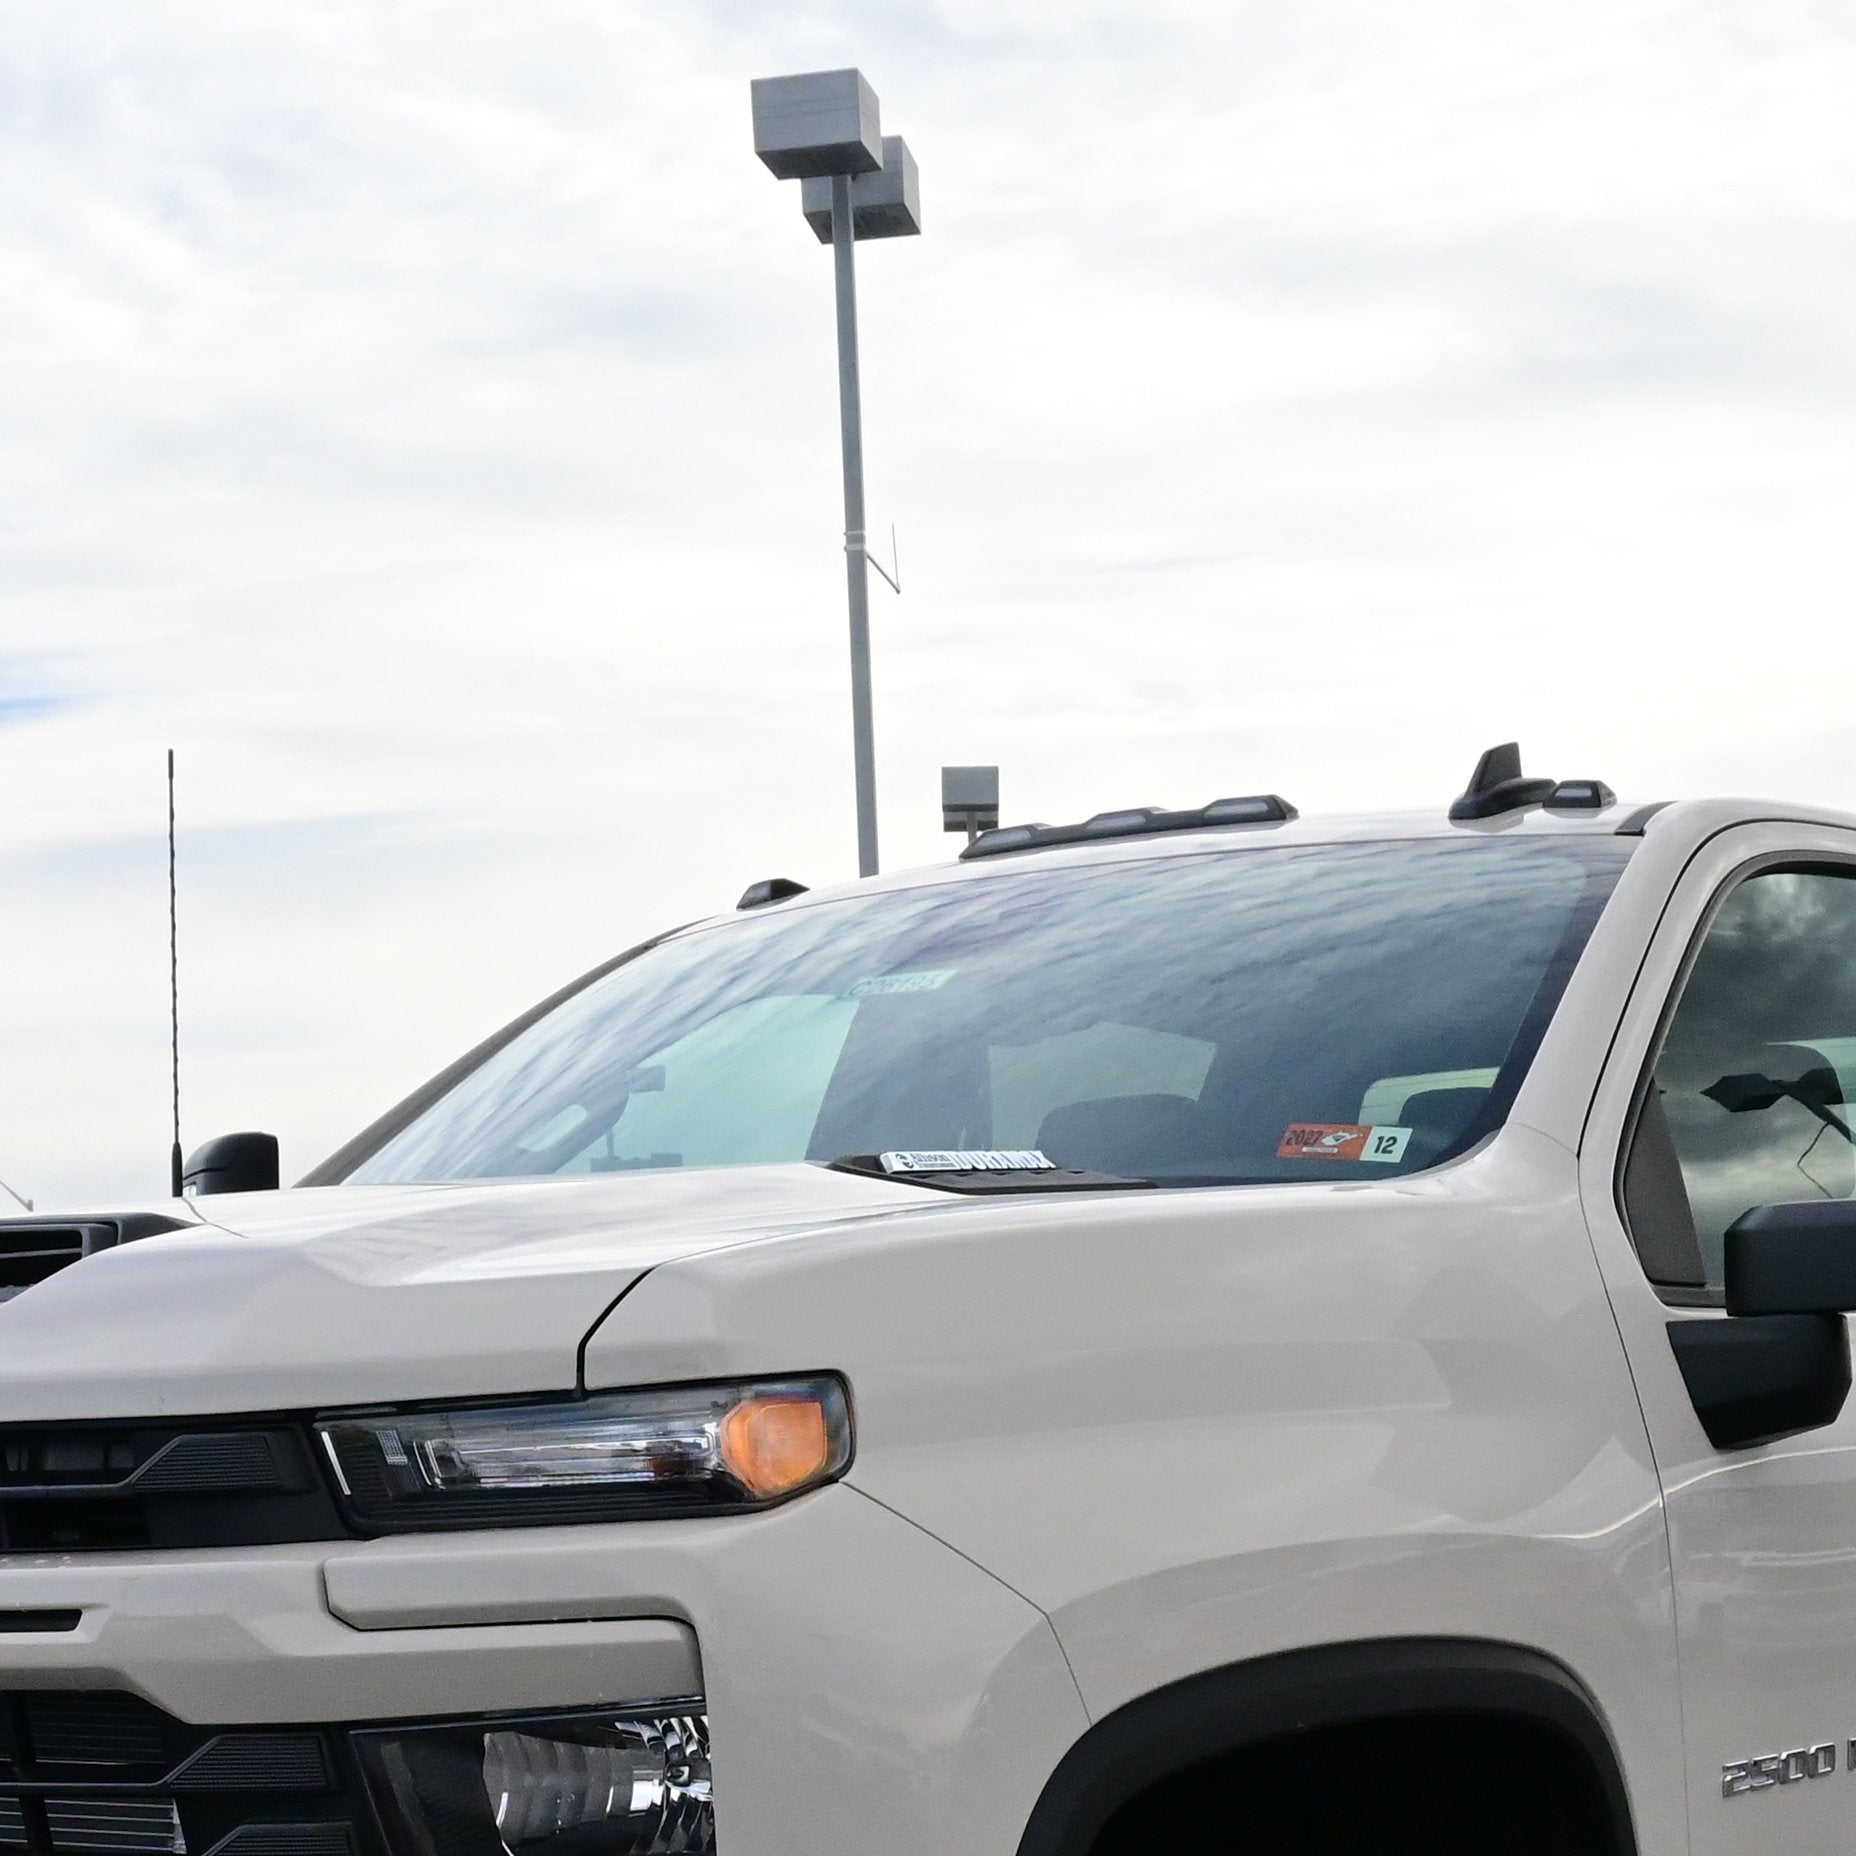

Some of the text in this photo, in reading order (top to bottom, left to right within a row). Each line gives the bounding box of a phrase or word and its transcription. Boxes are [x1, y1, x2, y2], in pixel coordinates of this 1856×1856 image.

[1285, 1129, 1398, 1154] 2027 12
[1722, 1741, 1837, 1799] 2500
